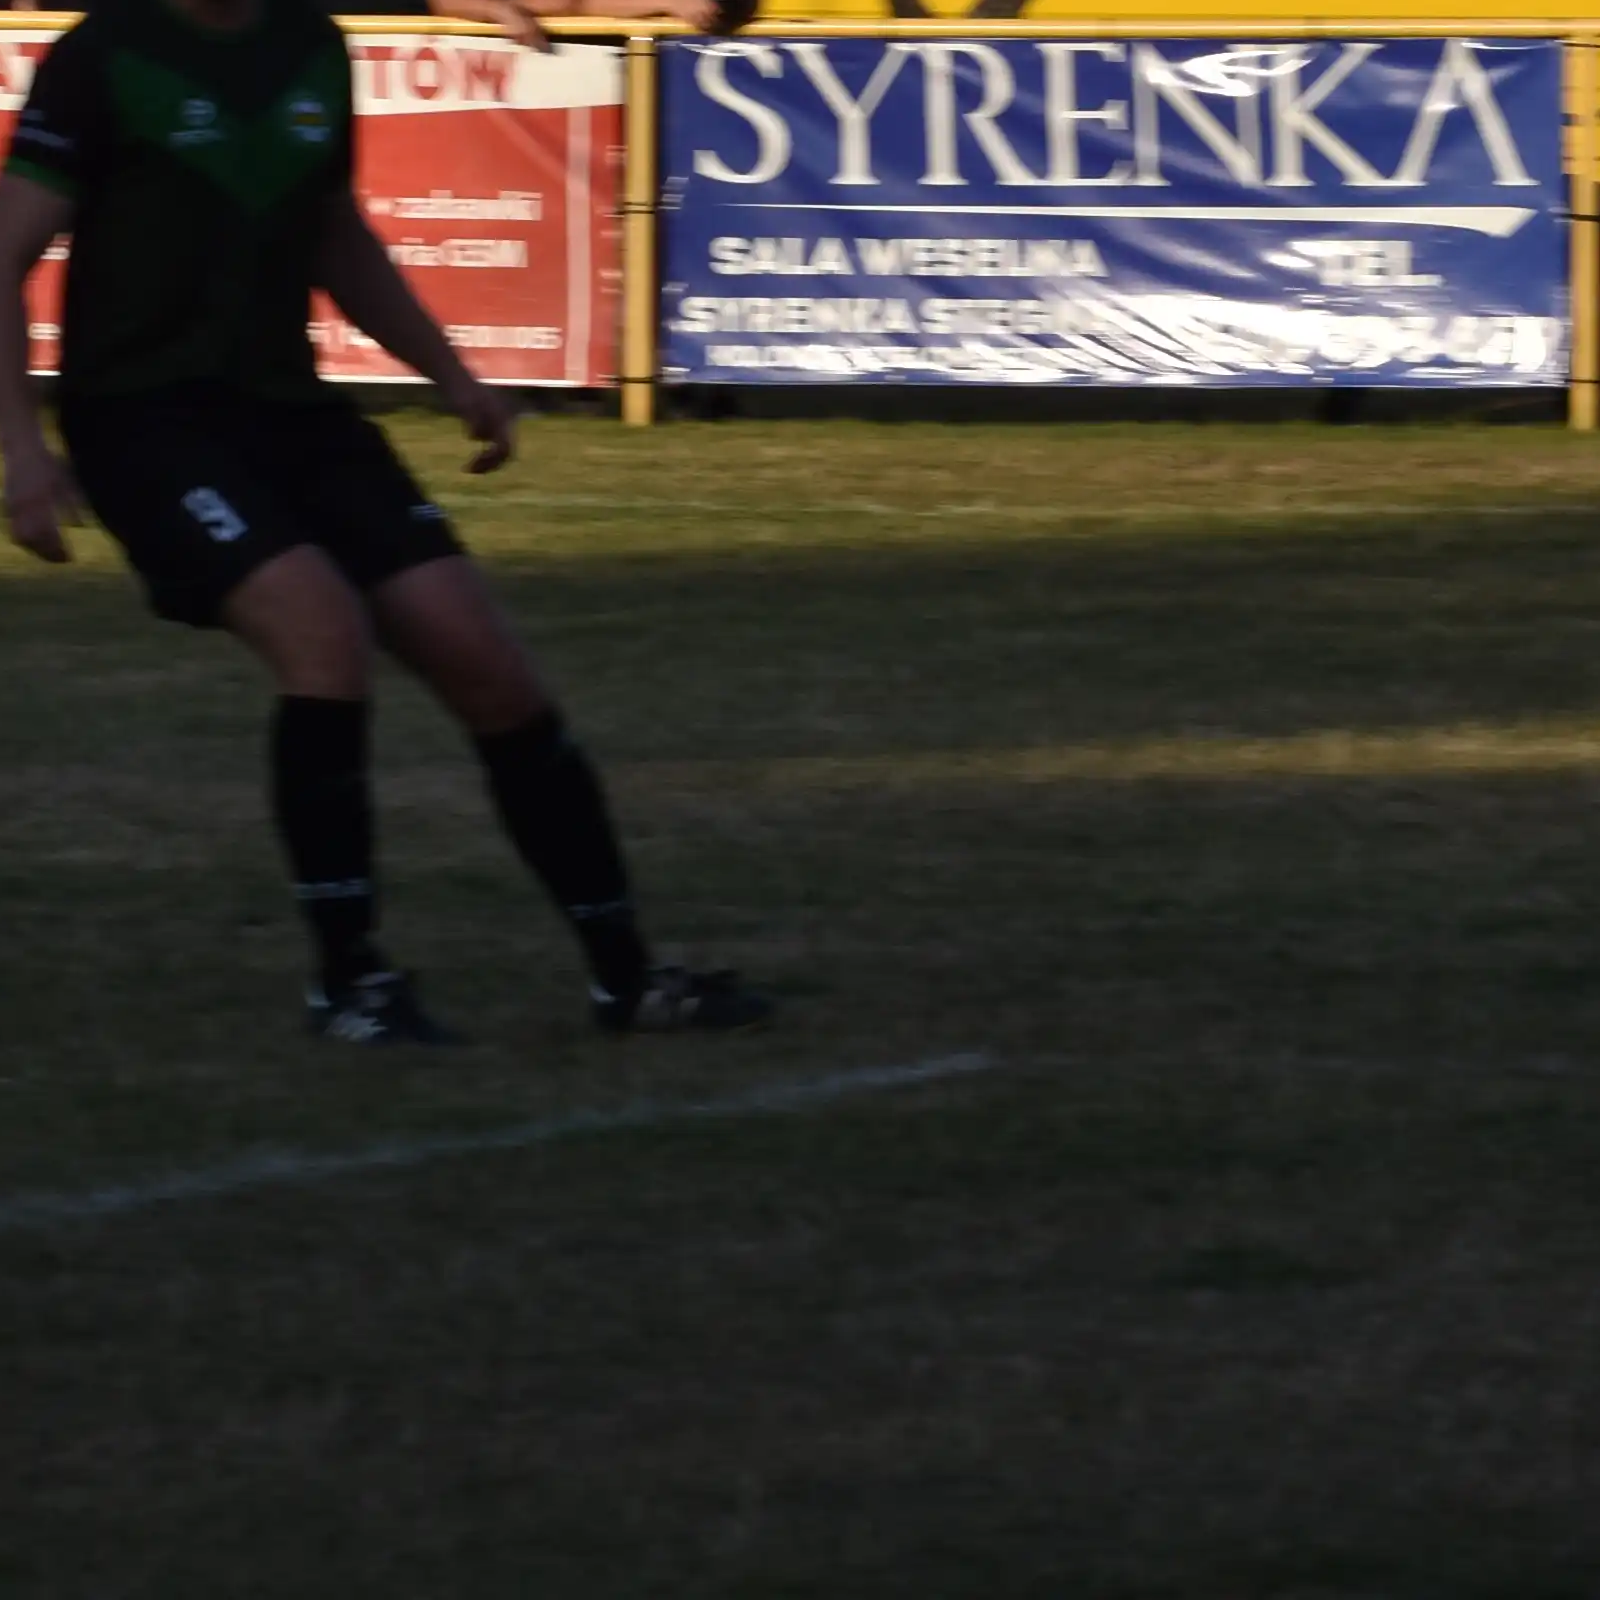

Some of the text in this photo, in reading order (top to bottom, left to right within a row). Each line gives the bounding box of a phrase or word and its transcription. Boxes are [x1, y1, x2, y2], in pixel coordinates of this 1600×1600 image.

[694, 41, 1540, 187] SYRENKA
[708, 237, 1108, 278] SALA WESELNA
[680, 297, 914, 334] SYRENKA
